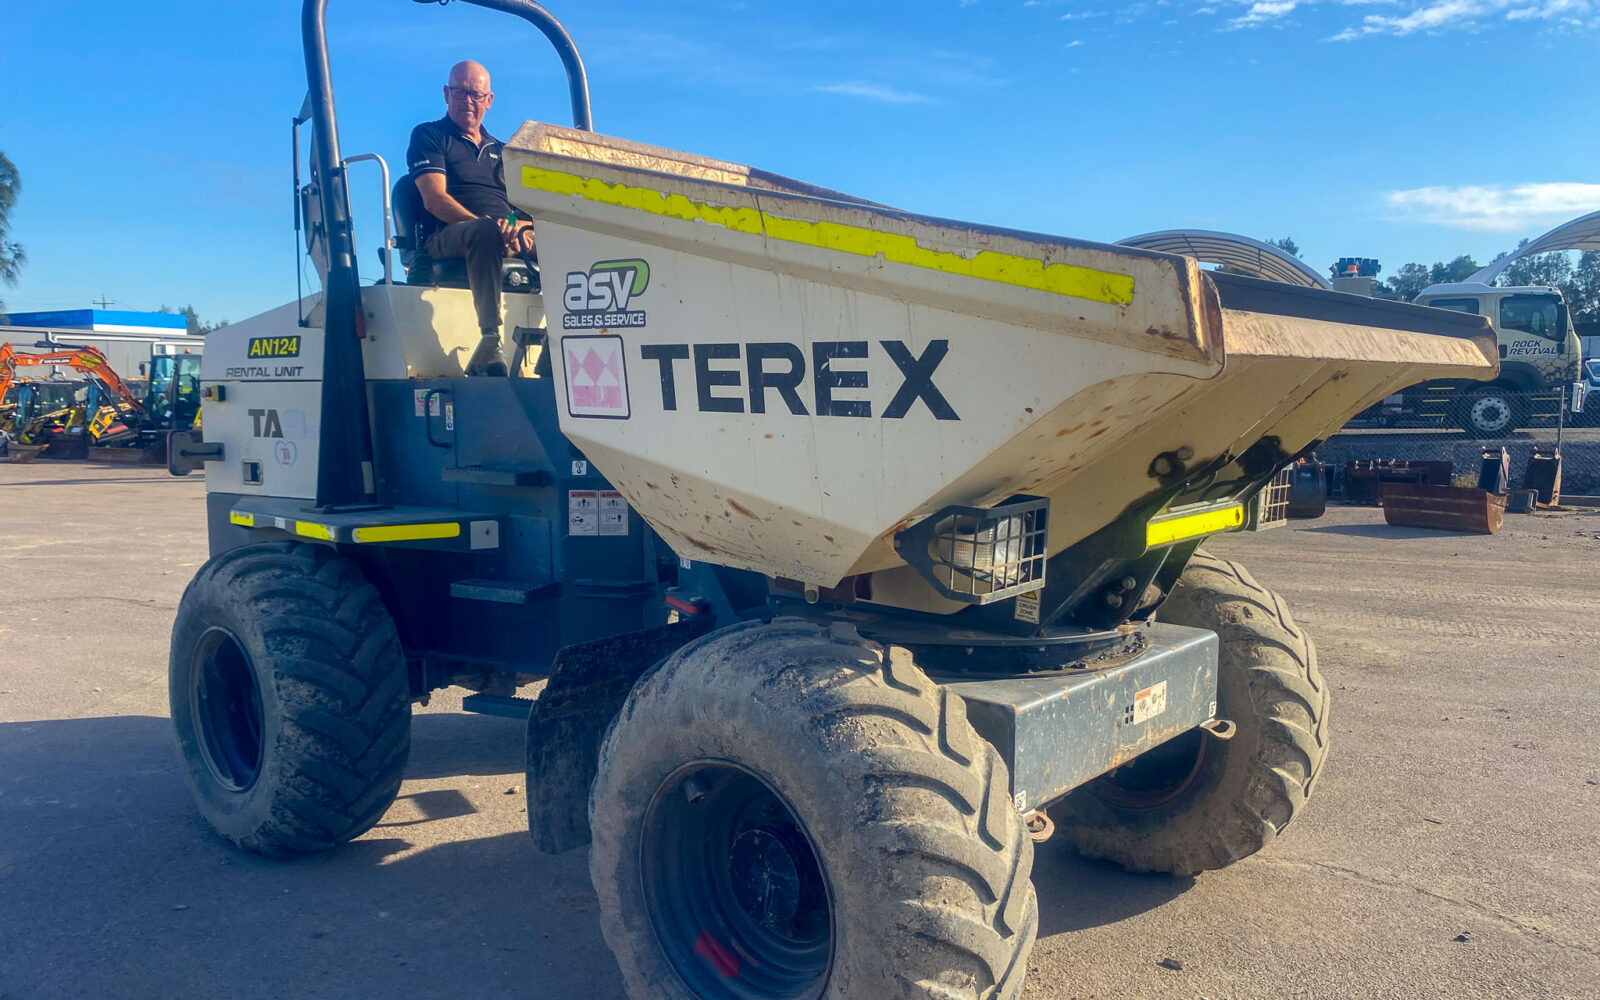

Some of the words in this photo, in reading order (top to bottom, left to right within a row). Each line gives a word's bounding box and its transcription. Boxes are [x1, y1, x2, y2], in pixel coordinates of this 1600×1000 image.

[594, 315, 604, 326] &
[604, 313, 644, 325] SERVICE
[250, 337, 298, 356] AN124
[1510, 347, 1556, 355] REVIVAL
[226, 367, 270, 377] RENTAL
[275, 366, 304, 377] UNIT
[640, 339, 962, 421] TEREX
[248, 408, 284, 438] TA
